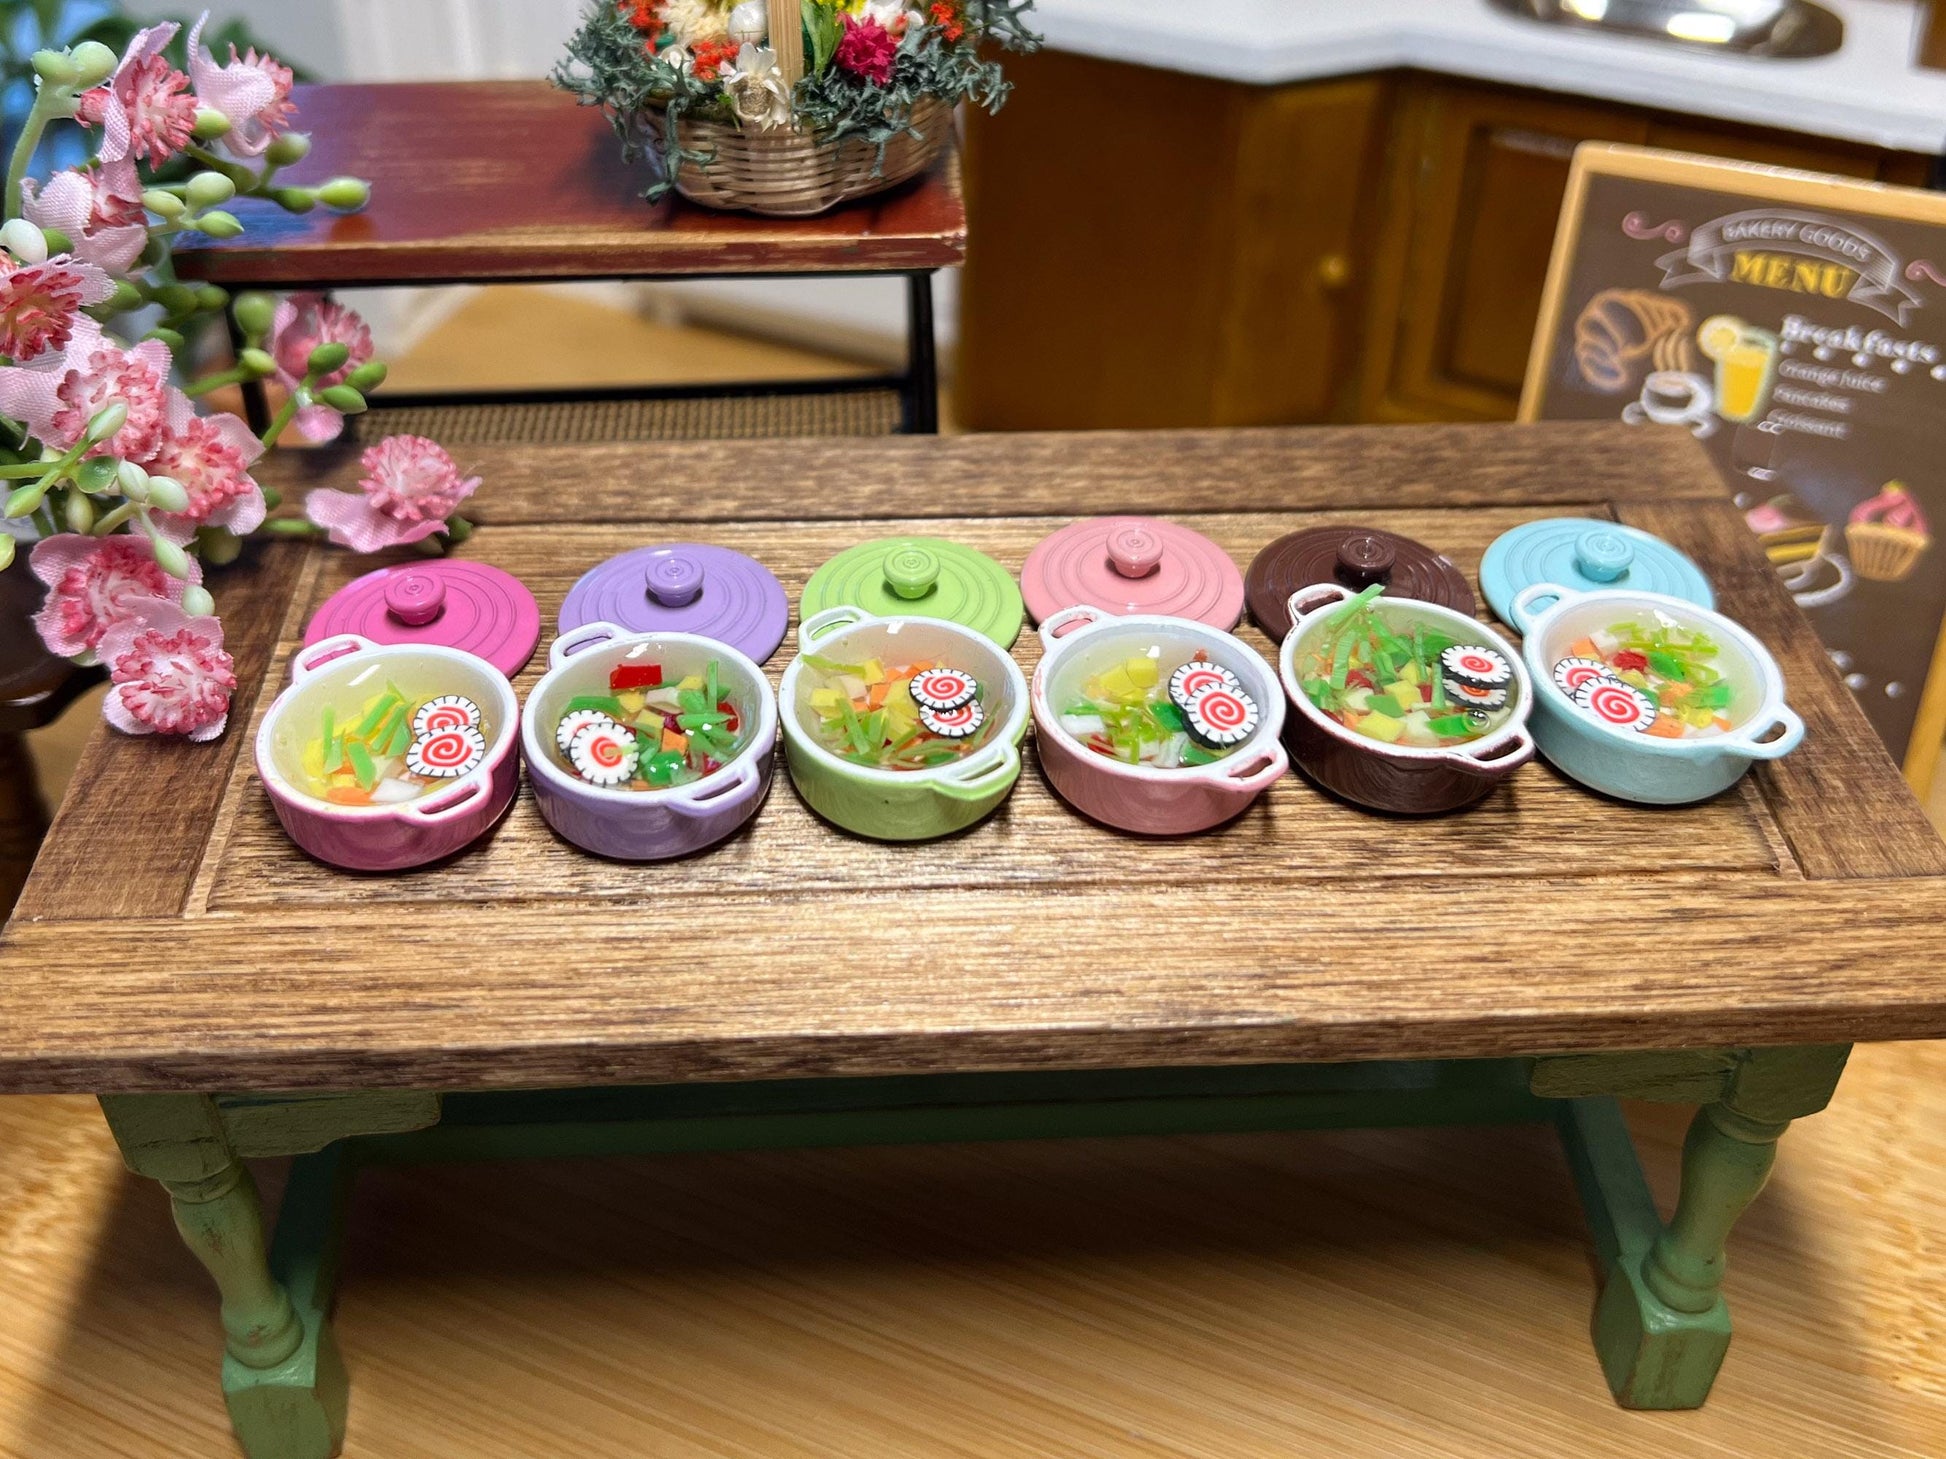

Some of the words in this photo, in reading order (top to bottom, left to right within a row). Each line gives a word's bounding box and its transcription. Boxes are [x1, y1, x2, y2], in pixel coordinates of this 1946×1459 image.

[1722, 219, 1800, 242] BAKERY
[1800, 224, 1872, 262] GOODS
[1730, 250, 1857, 299] MENU
[1781, 314, 1940, 364] Breakfasts
